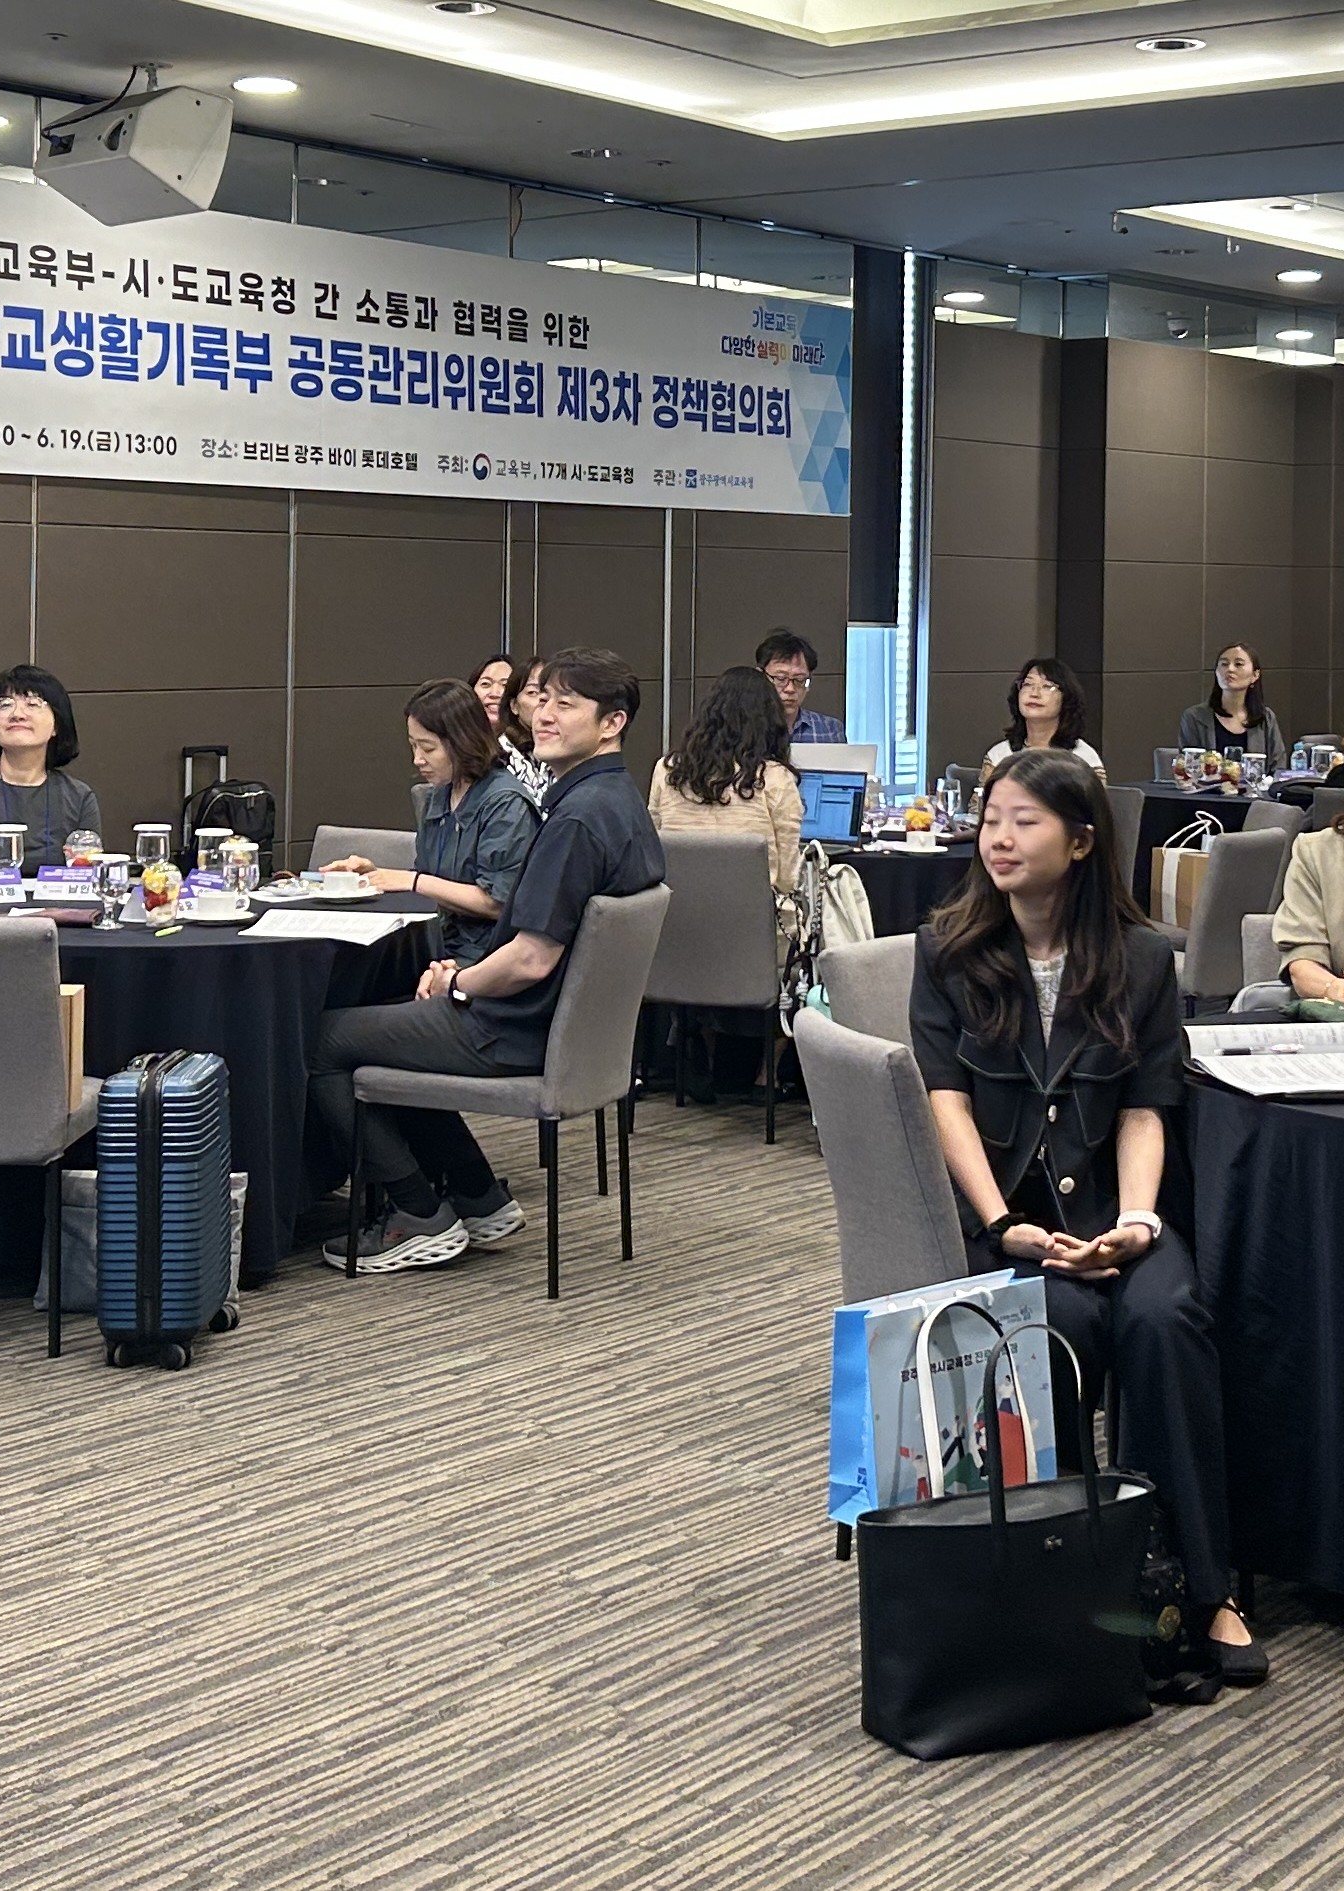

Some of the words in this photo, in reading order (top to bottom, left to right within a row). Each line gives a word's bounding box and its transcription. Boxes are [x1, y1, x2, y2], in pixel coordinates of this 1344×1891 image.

[314, 281, 341, 322] 간
[356, 288, 439, 334] 소통과
[452, 301, 530, 344] 협력을
[542, 312, 591, 351] 위한
[721, 334, 756, 358] 다양한
[287, 333, 544, 419] 공동관리위원회
[557, 364, 643, 427] 제3차
[652, 372, 792, 439] 정책협의회
[125, 433, 179, 457] 13:00
[200, 438, 239, 461] 장소:
[242, 441, 290, 464] 브리브
[293, 444, 325, 467] 광주
[328, 446, 358, 468] 바이
[361, 448, 419, 472] 롯데호텔
[436, 454, 469, 476] 주최:
[540, 461, 568, 482] 17개
